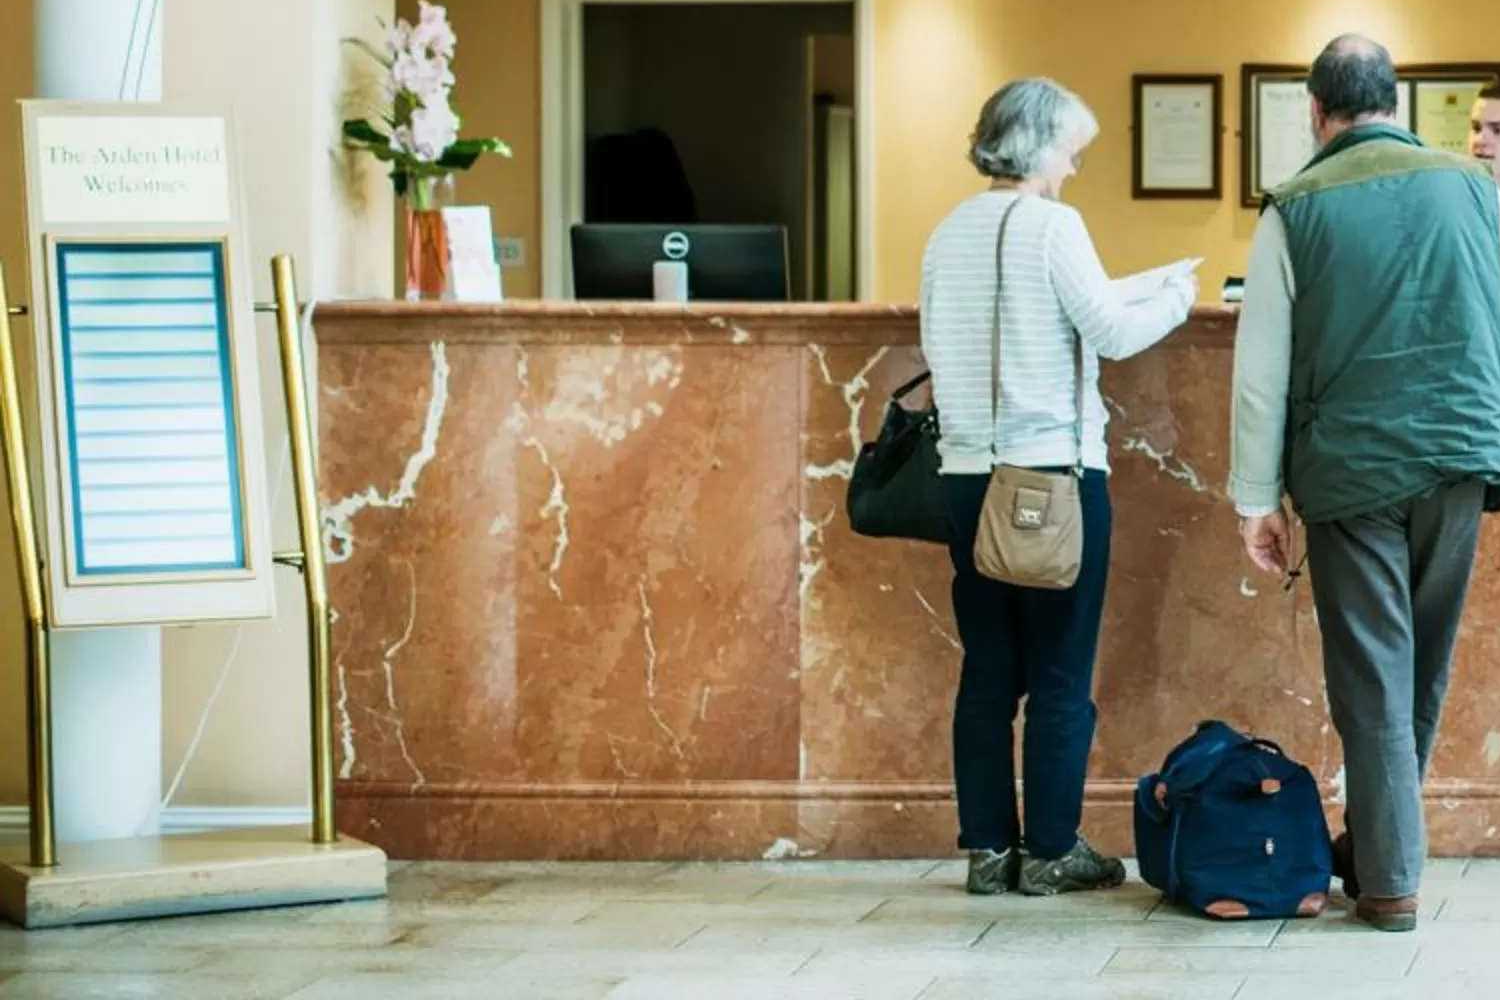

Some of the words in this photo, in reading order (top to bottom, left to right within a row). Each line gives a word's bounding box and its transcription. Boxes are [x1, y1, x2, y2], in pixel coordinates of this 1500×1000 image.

[47, 146, 84, 165] The
[96, 146, 158, 165] Arden
[163, 144, 222, 165] Hotel
